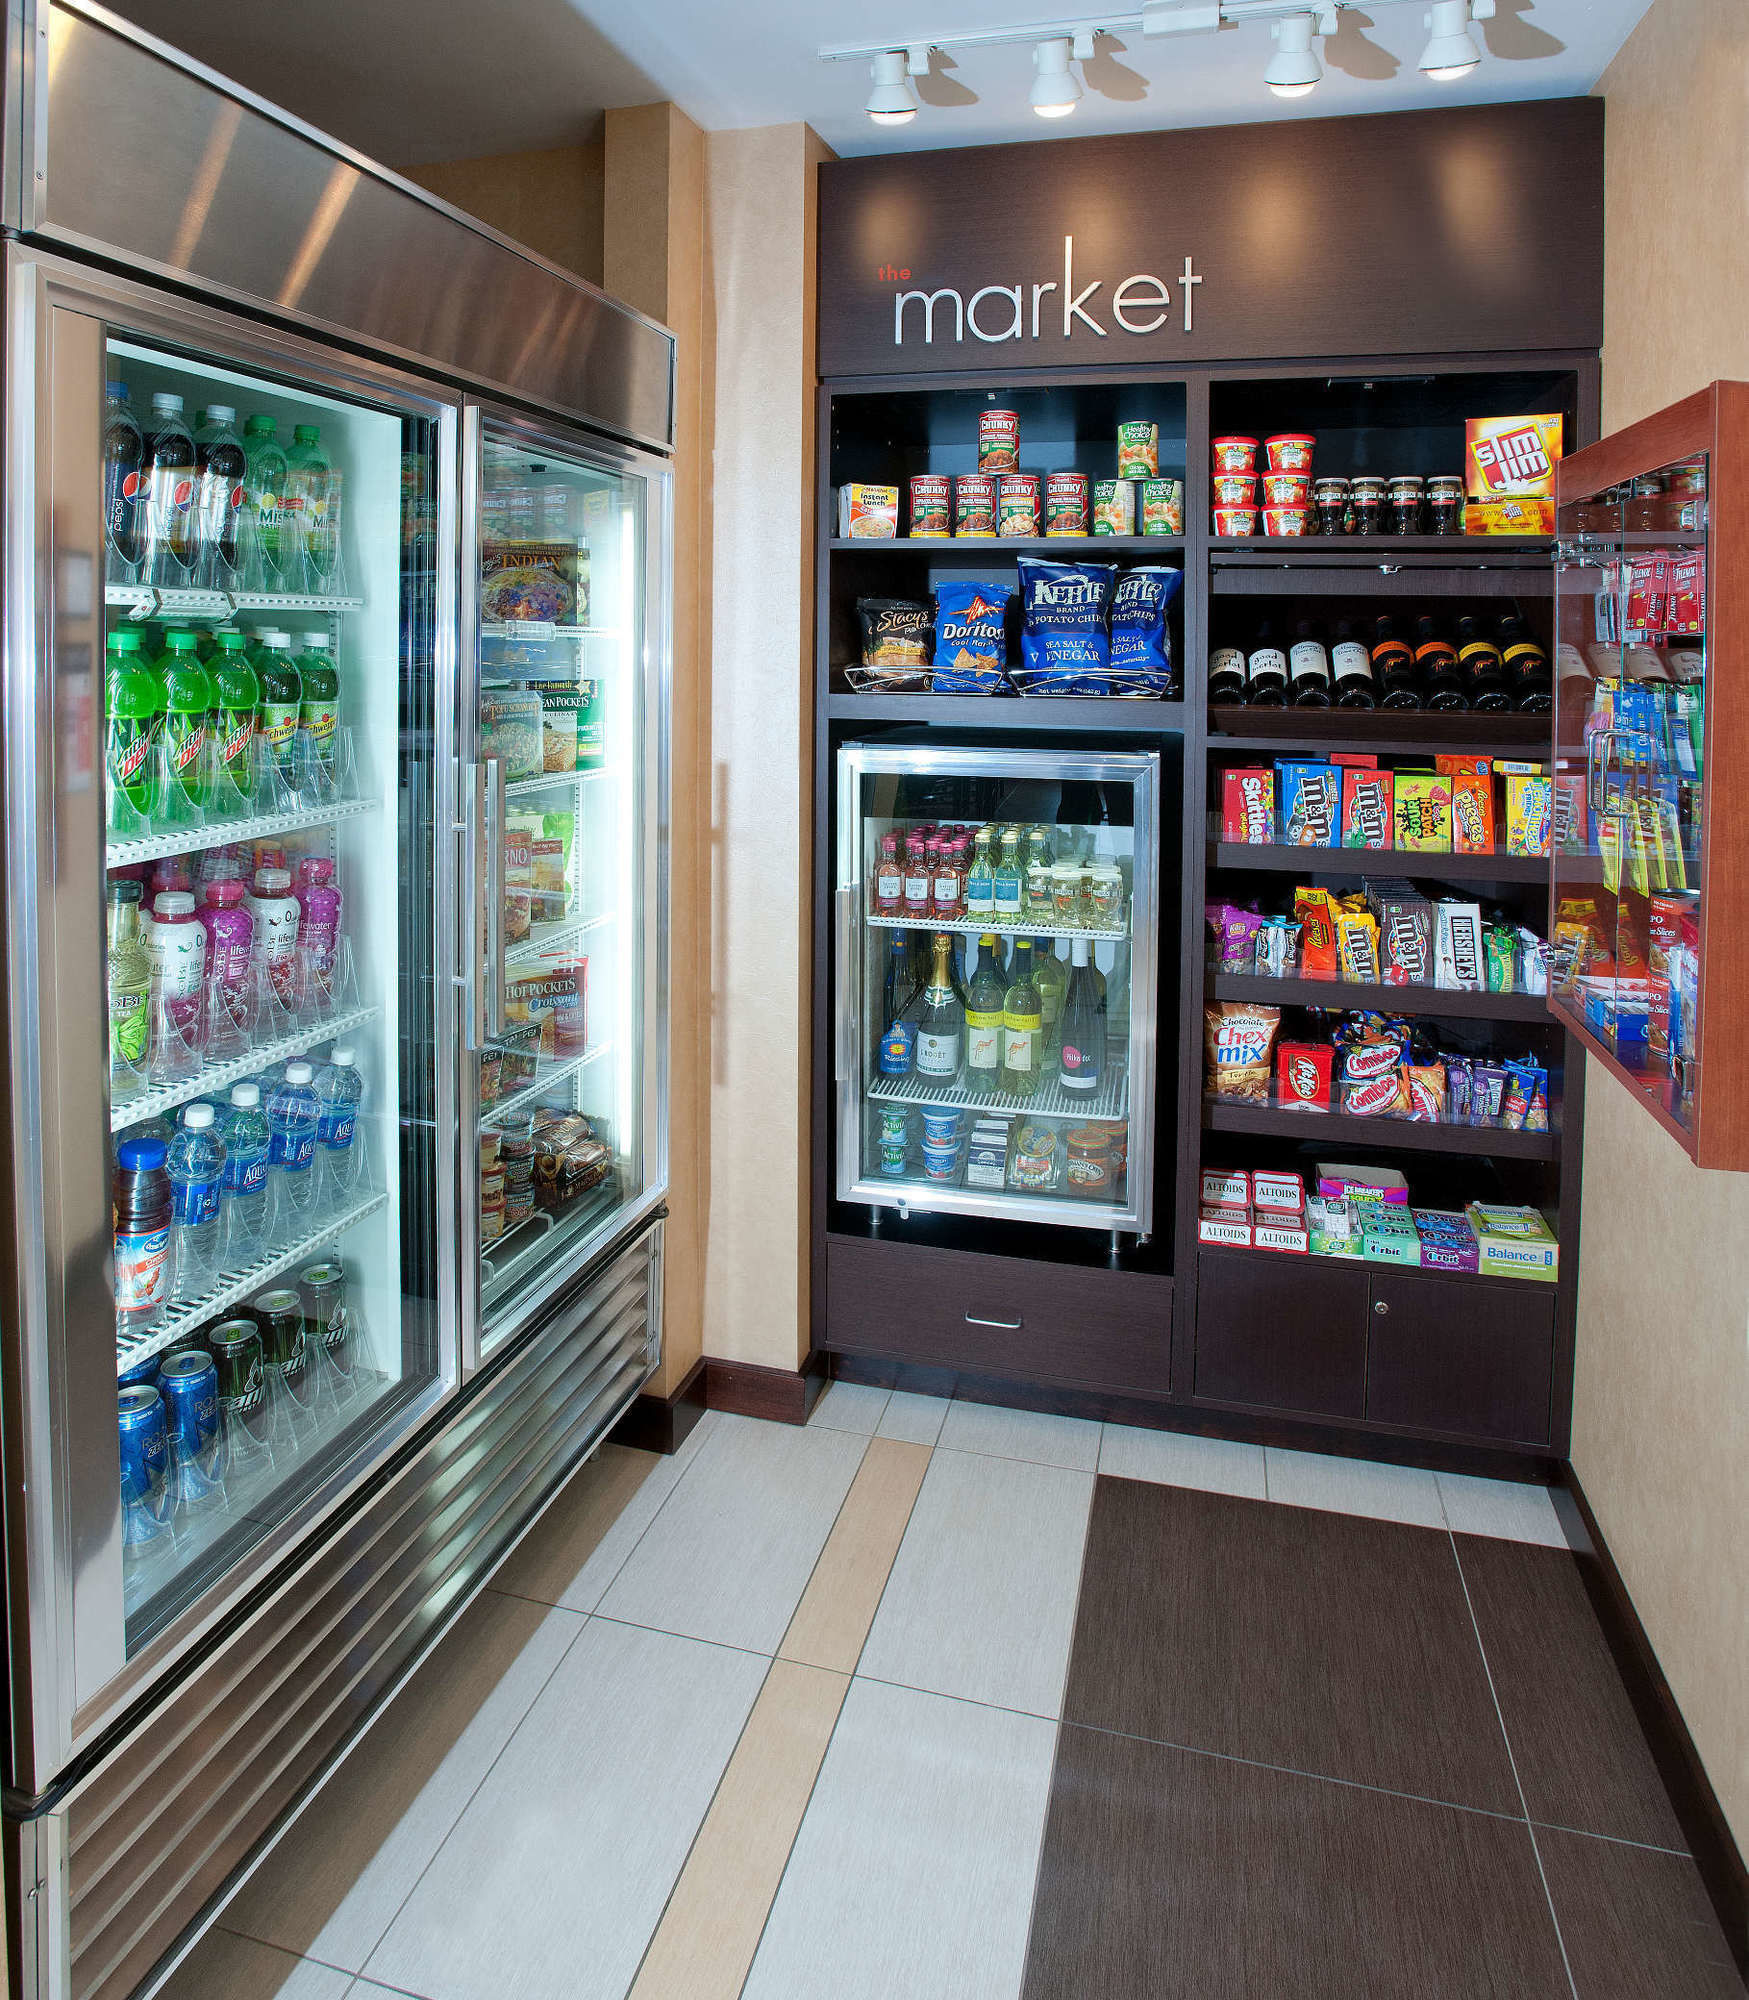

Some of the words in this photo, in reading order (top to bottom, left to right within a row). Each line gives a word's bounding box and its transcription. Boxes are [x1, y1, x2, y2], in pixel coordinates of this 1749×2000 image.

[878, 264, 912, 281] the
[895, 235, 1203, 345] market
[981, 420, 1014, 431] CHUNKY
[1127, 424, 1153, 433] Healthy
[1123, 431, 1151, 440] Choice
[914, 484, 947, 496] CHUNKY
[958, 484, 992, 496] CHUNKY
[1000, 483, 1034, 495] CHUNKY
[1047, 483, 1081, 494] CHUNKY
[1145, 489, 1173, 498] Choice
[860, 493, 889, 501] Instant
[113, 499, 124, 532] pepsi
[502, 553, 562, 569] INDIAN
[1033, 575, 1105, 605] KETTLE
[1056, 605, 1087, 613] BRAND
[877, 611, 929, 632] Stacy's
[1035, 614, 1075, 624] POTATO
[1046, 640, 1061, 649] SEA
[1062, 640, 1087, 648] SALT
[1111, 640, 1147, 655] NEGAR
[1046, 649, 1100, 662] VINEGAR
[1254, 652, 1278, 665] good
[557, 695, 590, 708] POCKETS
[1241, 777, 1266, 844] Skittles
[1453, 789, 1486, 844] Pieces
[1406, 799, 1422, 838] SOUR
[1420, 797, 1437, 839] PATCH
[1307, 918, 1324, 950] Reese's
[1656, 927, 1676, 938] Slices
[1452, 918, 1477, 979] HERSHEY'S
[505, 984, 528, 1000] HOT
[528, 977, 577, 997] POCKETS
[1221, 1017, 1265, 1027] Chocolate
[1213, 1026, 1268, 1046] Chex
[1217, 1044, 1268, 1065] mix
[1349, 1046, 1400, 1071] Combos
[1351, 1077, 1396, 1110] Combos
[1205, 1181, 1245, 1195] ALTOIDS
[1257, 1186, 1298, 1199] ALTOIDS
[1343, 1184, 1355, 1195] ICE
[1205, 1226, 1247, 1240] ALTOIDS
[1260, 1232, 1303, 1246] ALTOIDS
[1370, 1244, 1401, 1256] Orbit
[1426, 1250, 1460, 1264] Orbit
[1487, 1246, 1538, 1263] Balance
